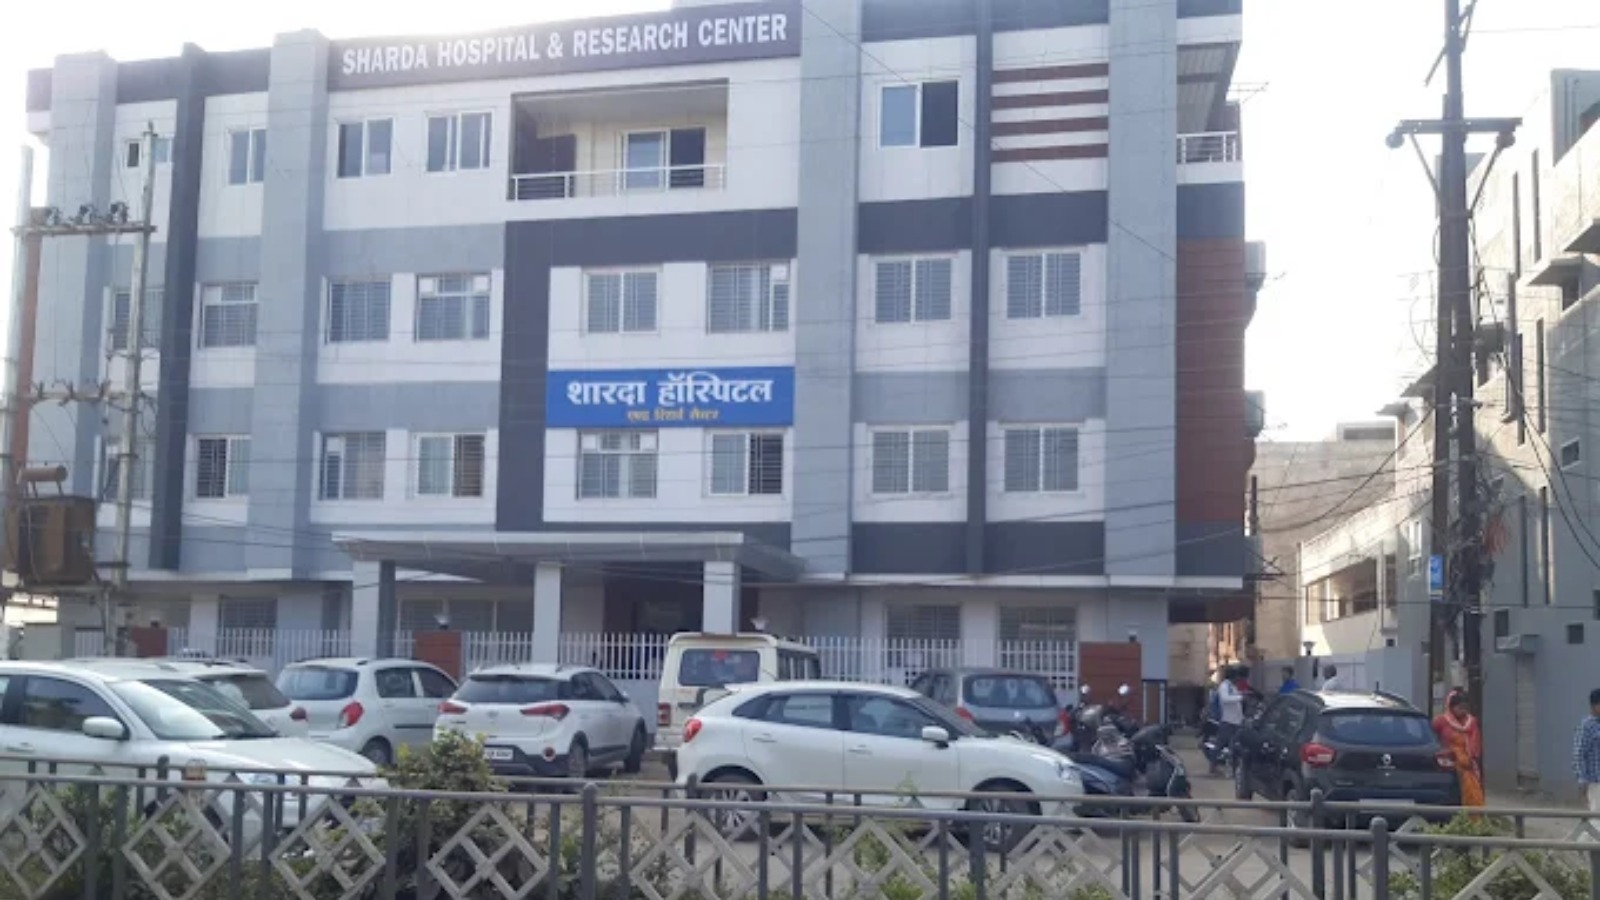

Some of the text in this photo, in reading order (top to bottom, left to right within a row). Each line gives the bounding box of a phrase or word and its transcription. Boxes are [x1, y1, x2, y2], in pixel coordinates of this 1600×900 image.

[343, 13, 788, 74] SHARDA HOSPITAL & RESEARCH CENTER
[567, 372, 772, 406] शारदा हॉस्पिटल
